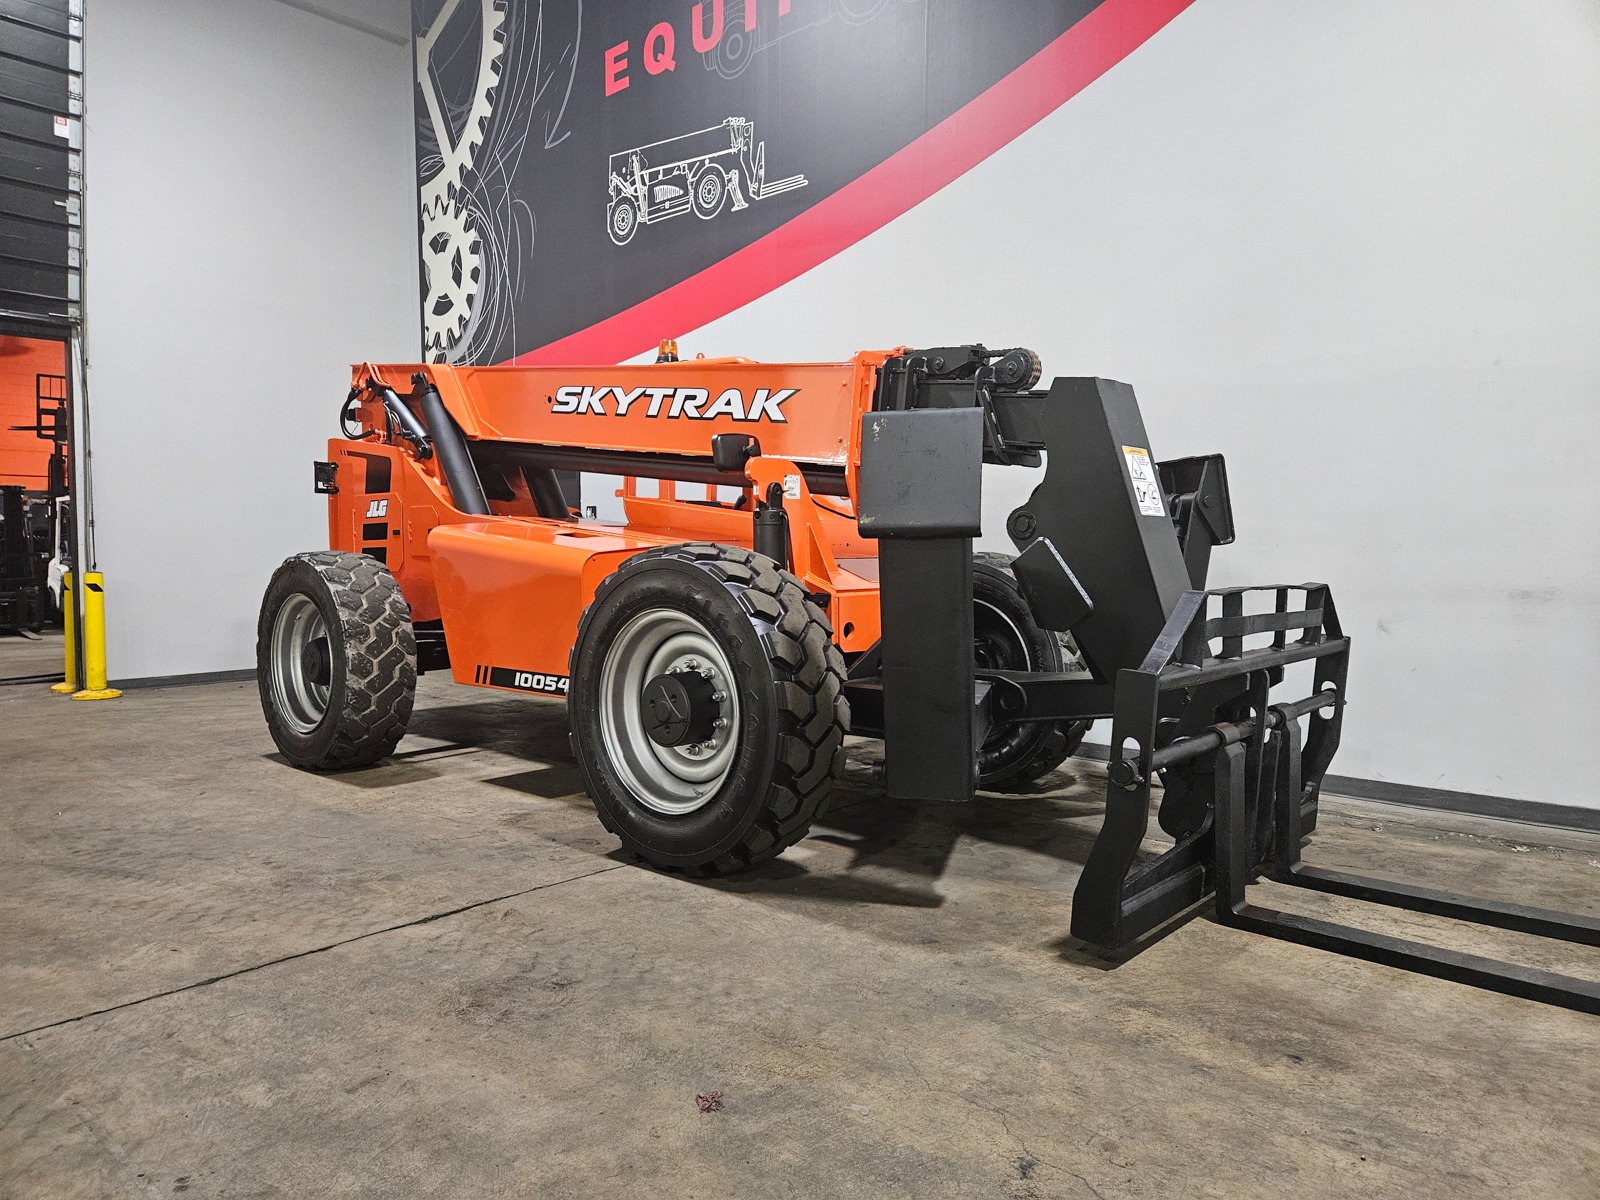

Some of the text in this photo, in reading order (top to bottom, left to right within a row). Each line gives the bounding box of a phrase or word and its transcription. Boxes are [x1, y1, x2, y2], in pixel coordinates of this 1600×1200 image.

[605, 0, 791, 97] EQUI
[551, 386, 801, 423] SKYTRAK
[366, 499, 388, 518] JLG
[514, 671, 570, 693] 10054
